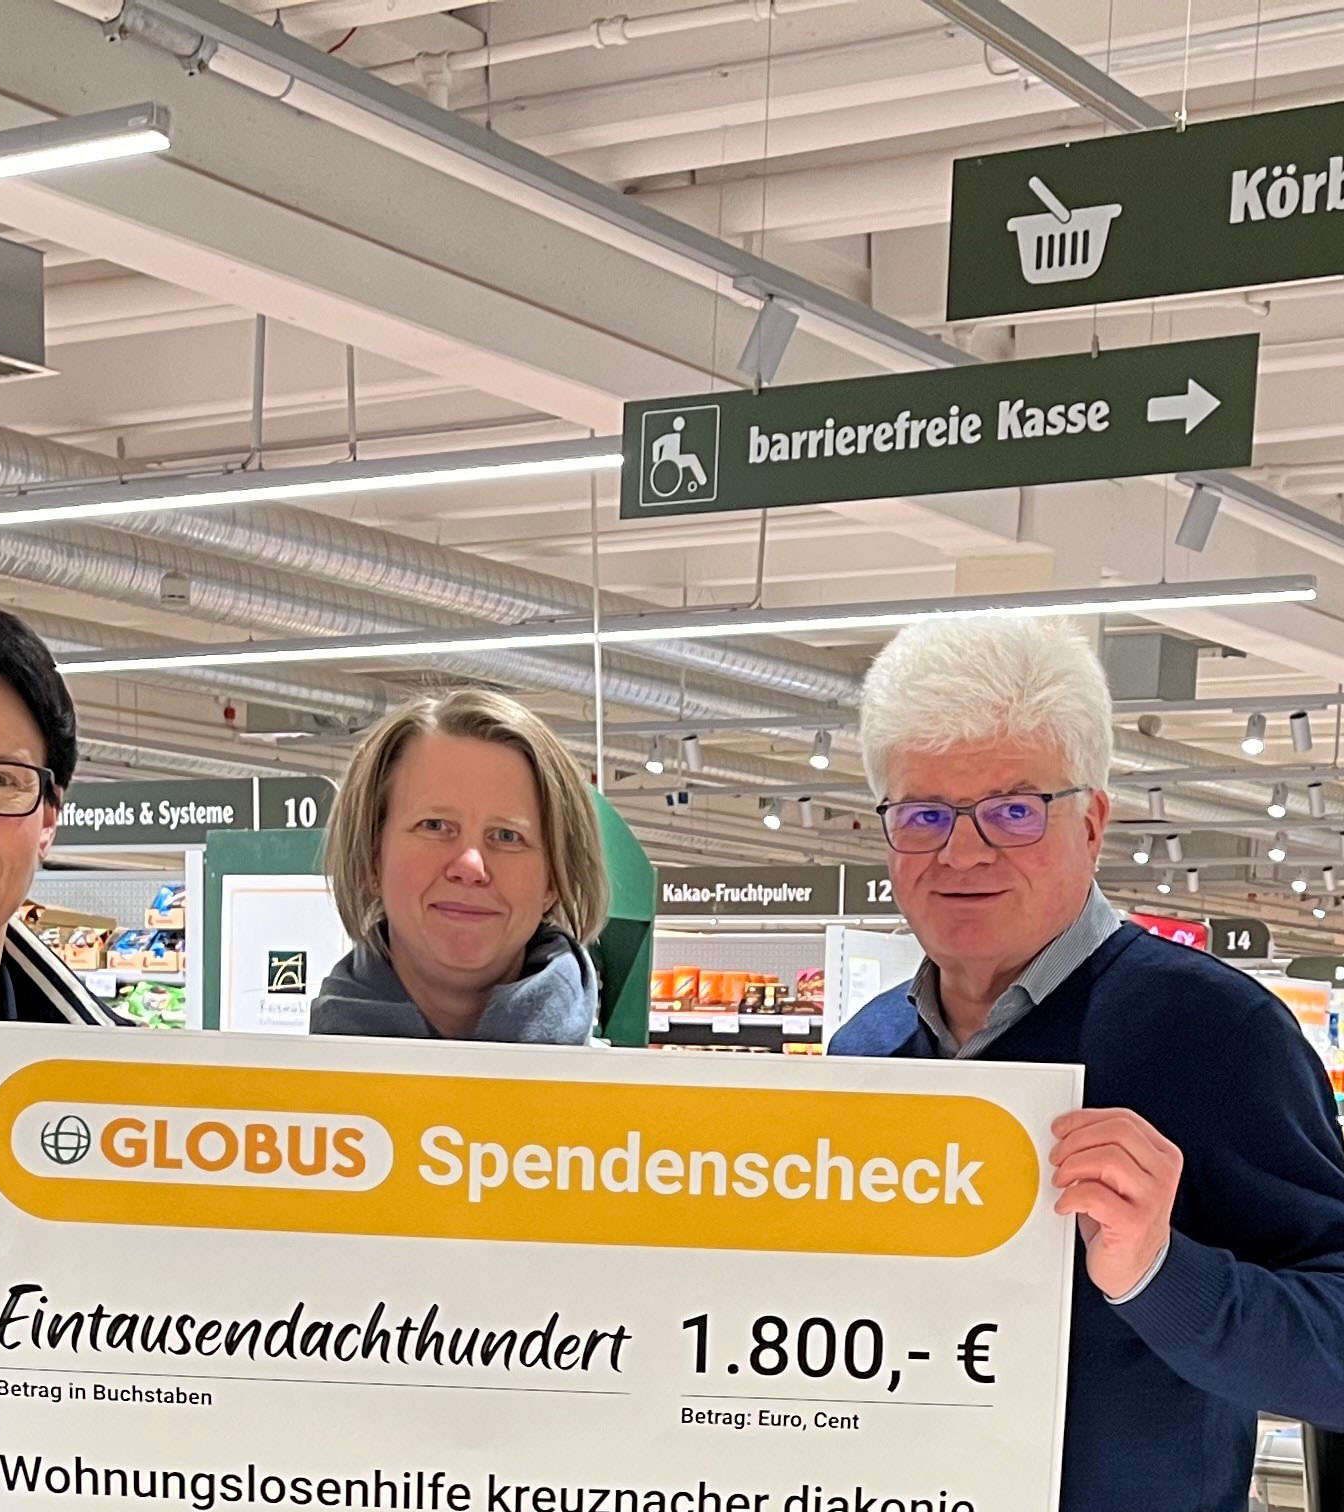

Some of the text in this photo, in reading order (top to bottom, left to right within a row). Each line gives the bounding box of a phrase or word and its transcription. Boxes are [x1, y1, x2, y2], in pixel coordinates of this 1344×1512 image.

[748, 399, 1111, 464] barrierefreie Kasse
[56, 797, 318, 831] affeepads & Systeme 10
[662, 879, 892, 906] Kakao-Fruchtpulver 12
[1226, 930, 1252, 951] 14
[99, 1116, 985, 1207] GLOBUS Spendenscheck
[680, 1313, 999, 1394] 1.800,- €
[68, 1382, 87, 1401] in
[92, 1384, 214, 1407] Buchstaben
[680, 1407, 860, 1432] Betrag: Euro, Cent
[0, 1454, 472, 1512] Wohnungslosenhilfe
